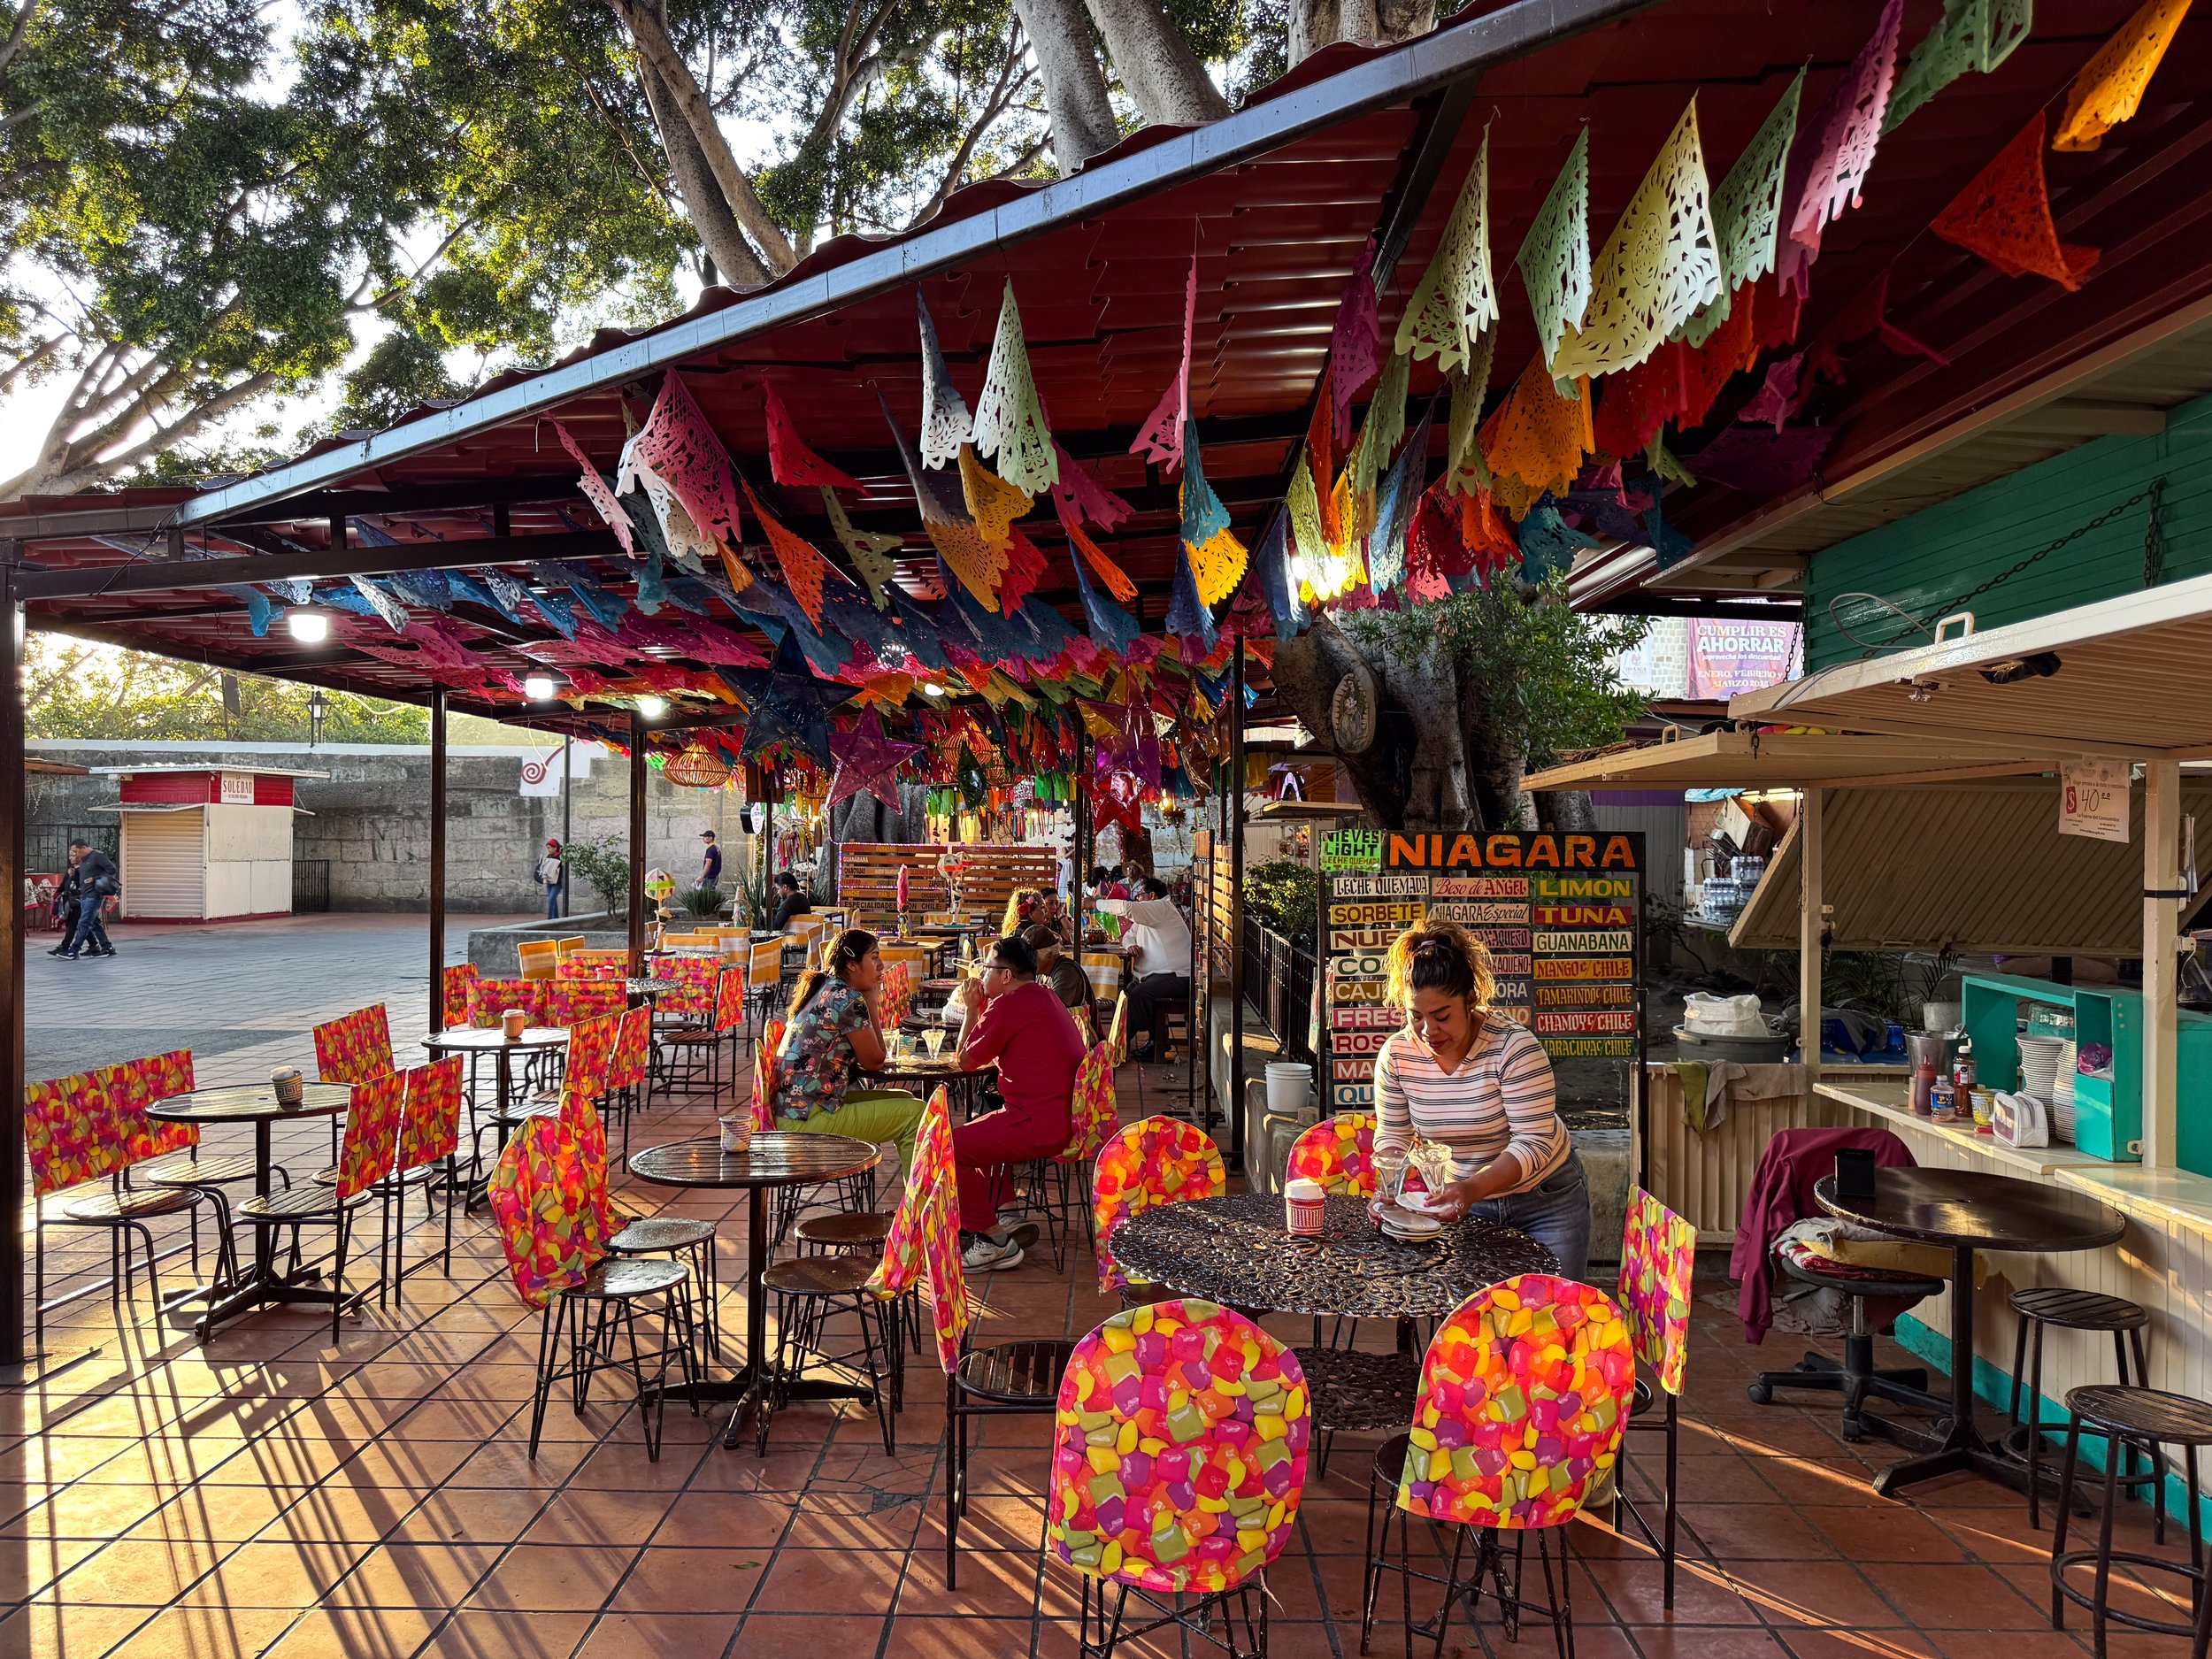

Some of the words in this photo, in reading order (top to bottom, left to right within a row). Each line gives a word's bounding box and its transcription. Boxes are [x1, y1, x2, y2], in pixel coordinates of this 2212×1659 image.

[1697, 625, 1766, 637] CUMPLIR
[1769, 626, 1787, 637] ES
[1696, 636, 1786, 653] AHORRAR
[1734, 670, 1777, 679] FEBRERO
[223, 780, 253, 794] SOLEDAD
[1388, 834, 1636, 868] NIAGARA
[1336, 878, 1371, 895] LECHE
[1375, 877, 1427, 894] QUEMADA
[1434, 878, 1467, 895] Beso
[1469, 878, 1485, 895] de
[1484, 879, 1526, 895] ANGEL
[1540, 879, 1631, 896] LIMON
[1334, 903, 1422, 923] SORBETE
[1435, 904, 1483, 921] NIAGARA
[1482, 903, 1530, 922] Especial
[1538, 907, 1627, 924] TUNA
[1334, 931, 1401, 949] NUE
[1536, 933, 1629, 951] GUANABANA
[1337, 957, 1381, 975] CO
[1537, 961, 1578, 978] MANGO
[1593, 961, 1630, 977] CHILE
[1335, 983, 1386, 1000] CAJ
[1495, 982, 1528, 998] ORA
[1602, 987, 1632, 1004] CHILE
[1337, 1009, 1403, 1026] FRES
[1537, 1014, 1587, 1032] CHAMOY
[1597, 1014, 1632, 1031] CHILE
[1336, 1035, 1387, 1052] ROS
[1605, 1040, 1632, 1056] CHILE
